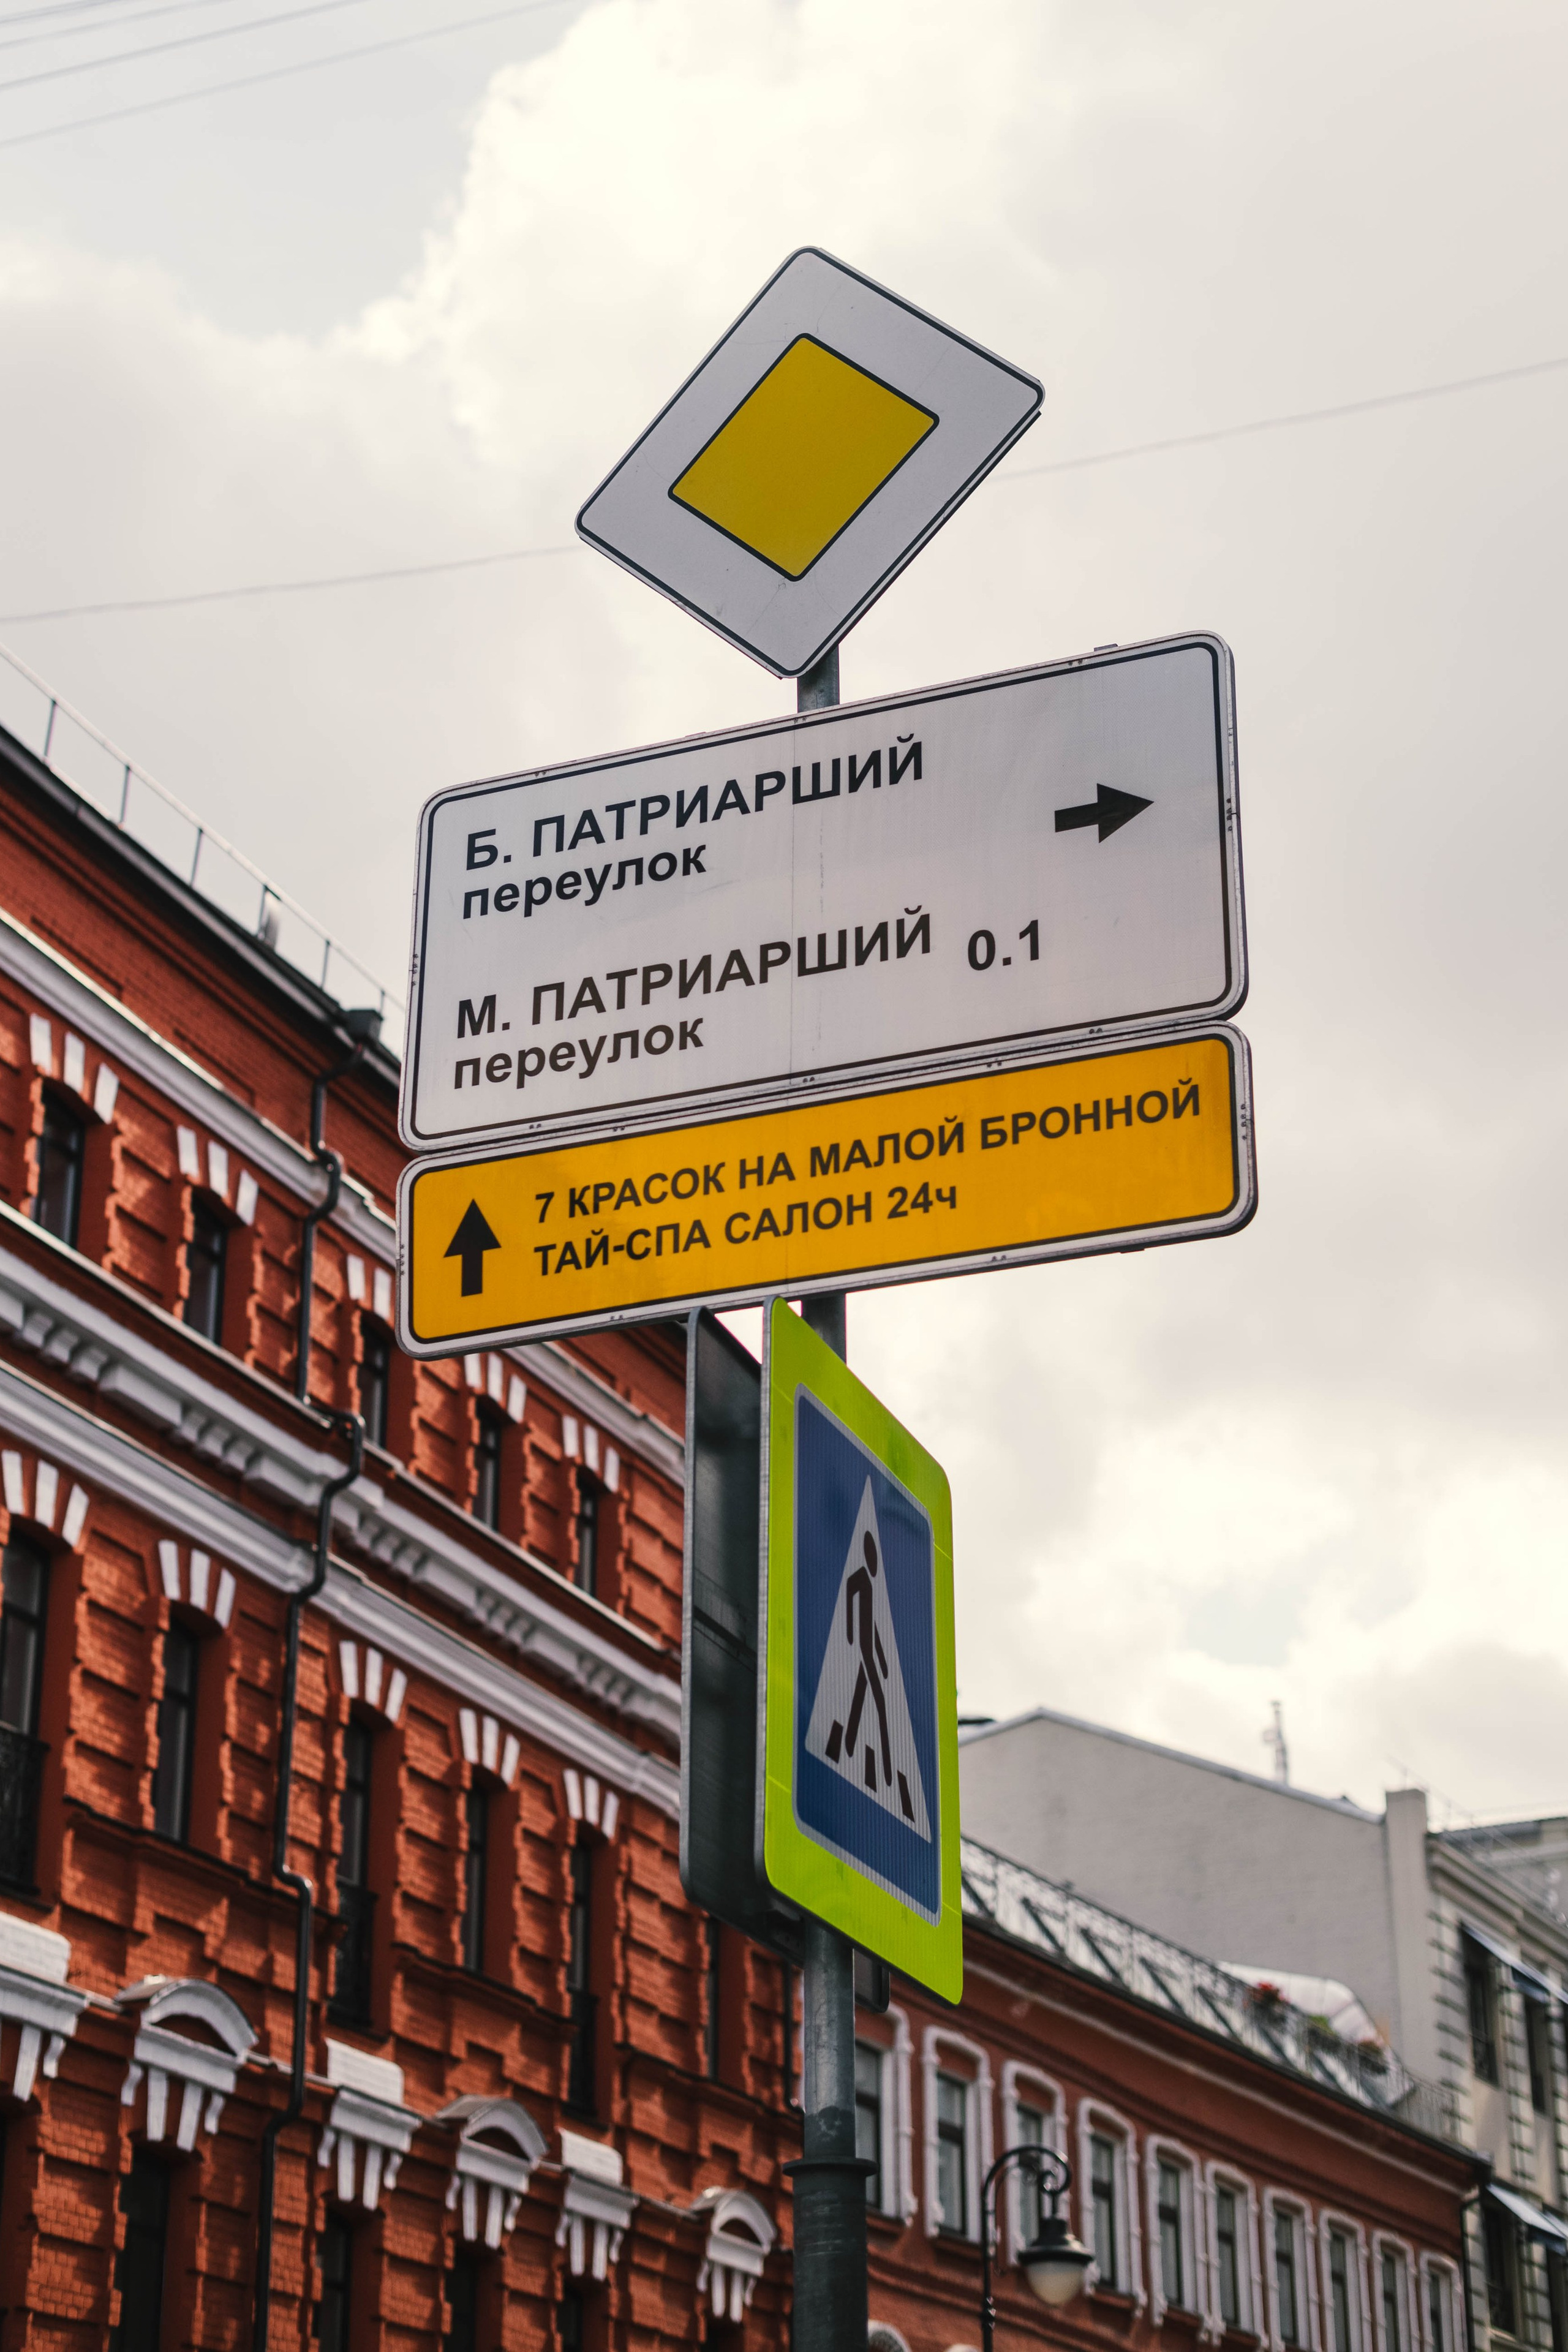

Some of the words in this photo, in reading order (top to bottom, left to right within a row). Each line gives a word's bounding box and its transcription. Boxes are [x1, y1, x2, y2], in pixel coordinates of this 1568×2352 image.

[466, 828, 511, 871] Б.
[533, 733, 922, 858] ПАТРИАРШИЙ
[463, 844, 707, 919] переулок
[457, 994, 510, 1039] М.
[532, 904, 930, 1025] ПАТРИАРШИЙ
[968, 919, 1039, 971] 0.1
[454, 1017, 704, 1090] переулок
[535, 1191, 554, 1223] 7
[568, 1162, 725, 1218] КРАСОК
[739, 1152, 796, 1189] НА
[810, 1116, 964, 1177] МАЛОЙ
[981, 1077, 1200, 1150] БРОННОЙ
[533, 1219, 710, 1276] ТАЙ-СПА
[725, 1191, 872, 1244] САЛОН
[888, 1182, 956, 1219] 24ч
